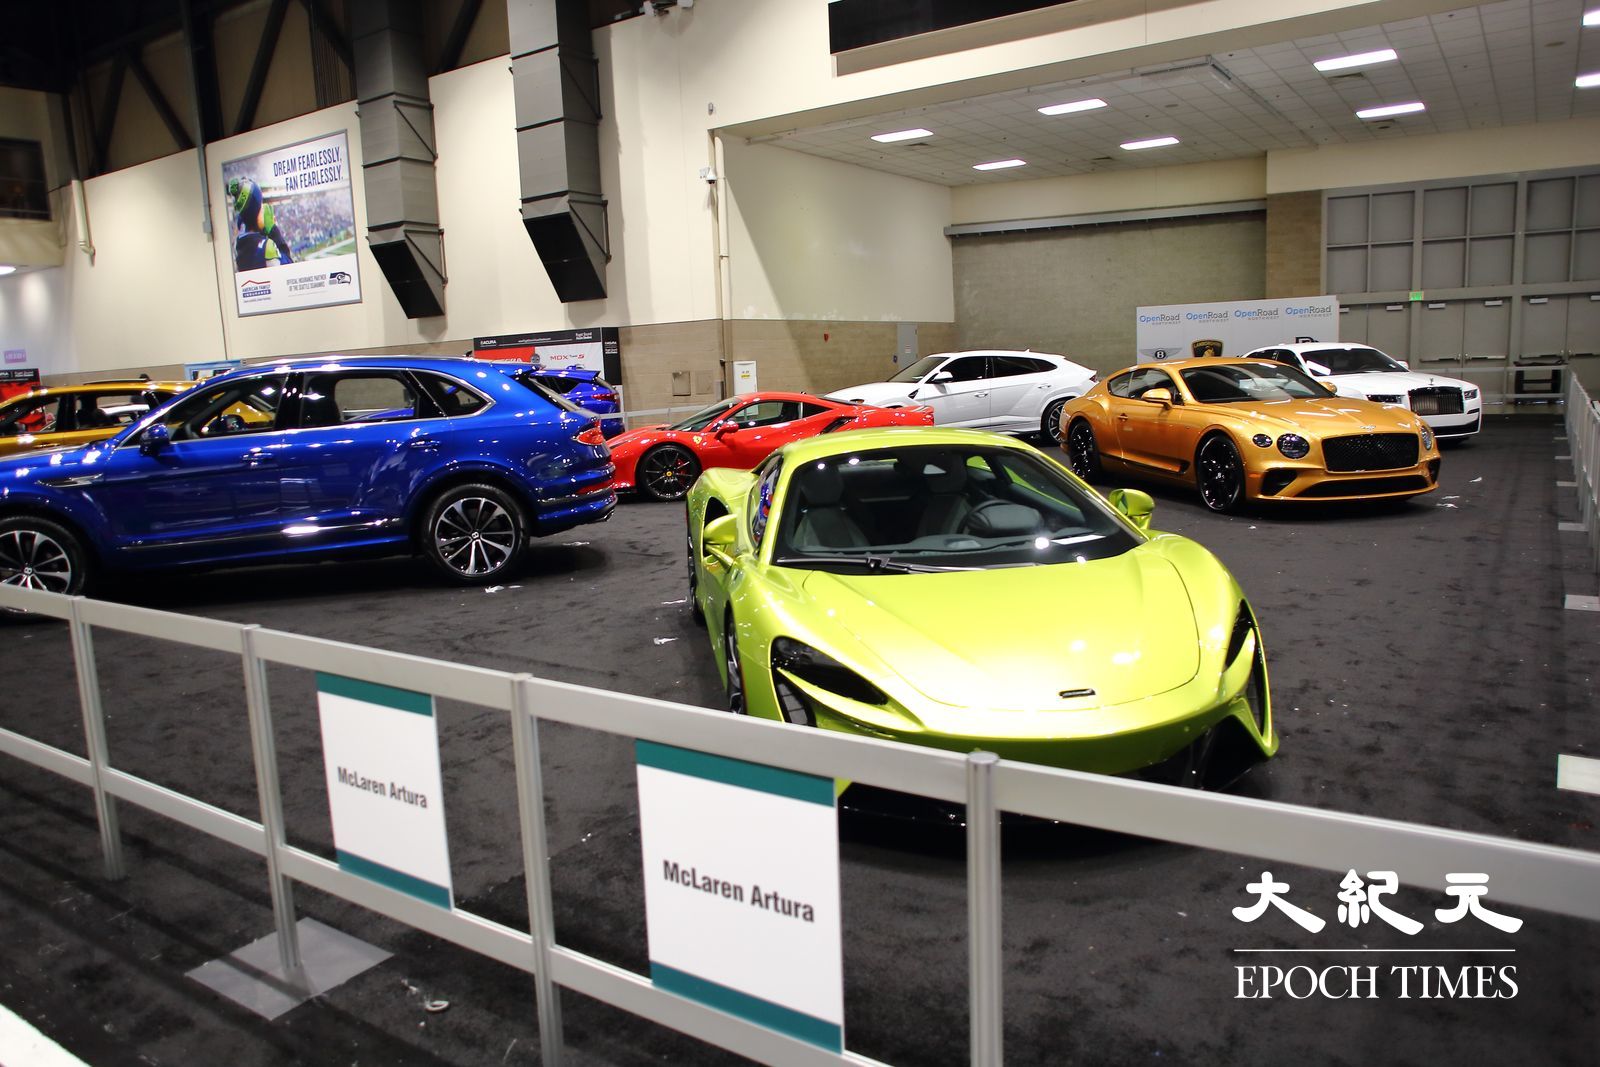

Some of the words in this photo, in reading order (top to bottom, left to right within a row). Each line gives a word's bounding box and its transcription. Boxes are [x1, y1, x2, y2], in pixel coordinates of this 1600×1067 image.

[273, 158, 297, 177] DREAM
[297, 146, 342, 171] FEARLESSLY.
[285, 175, 298, 192] FAN
[299, 165, 344, 189] FEARLESSLY.
[1139, 313, 1180, 323] OpenRoad
[1185, 311, 1229, 320] OpenRoad
[1234, 308, 1279, 318] OpenRoad
[1285, 305, 1332, 316] OpenRoad
[337, 766, 386, 796] McLaren
[390, 782, 427, 808] Artura
[663, 859, 744, 903] McLaren
[751, 885, 814, 922] Artura
